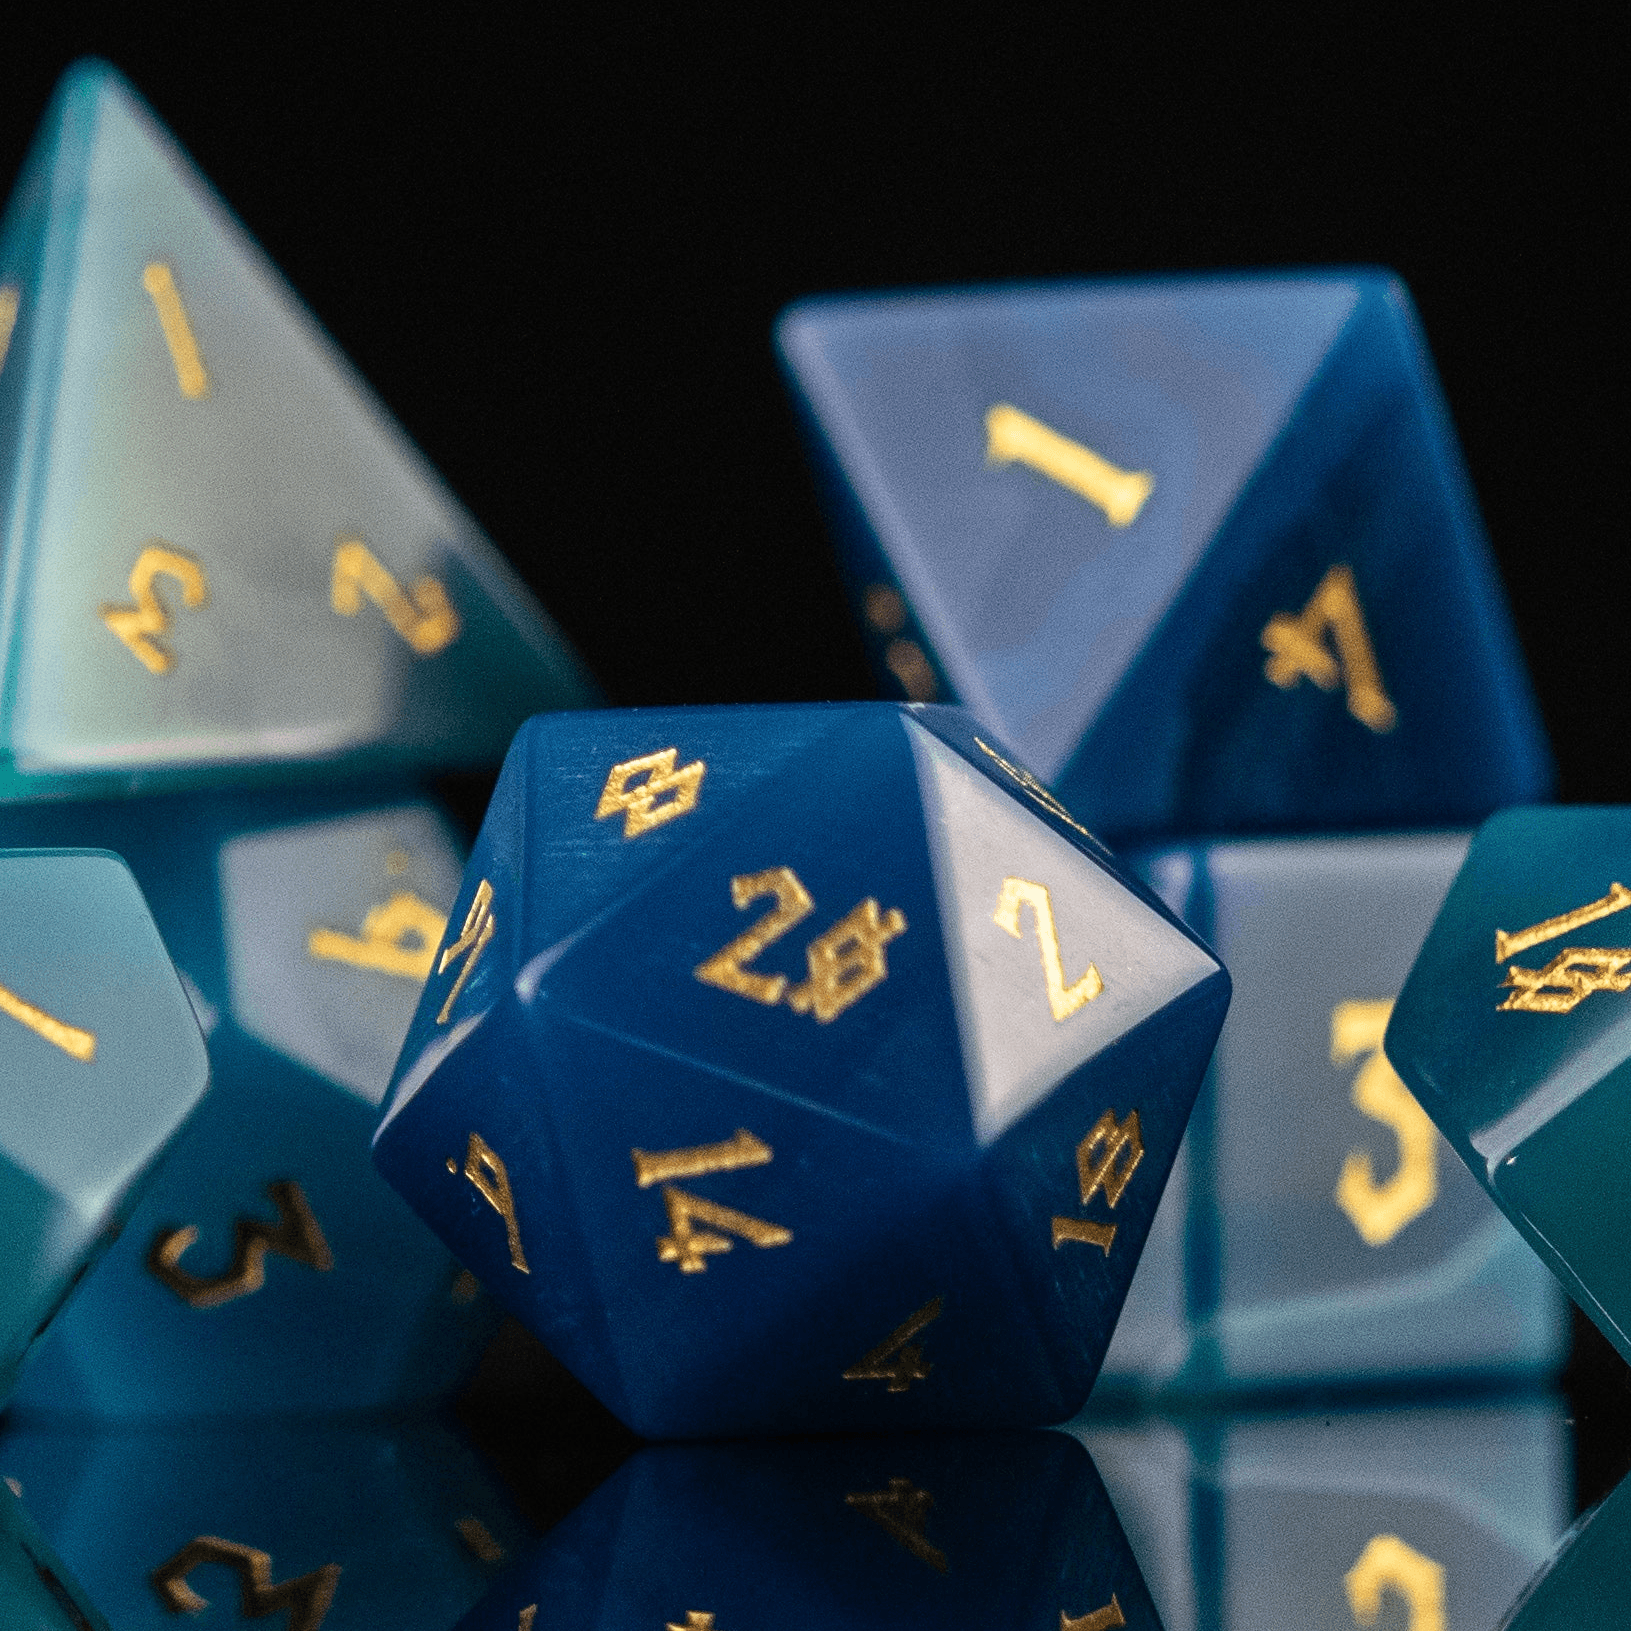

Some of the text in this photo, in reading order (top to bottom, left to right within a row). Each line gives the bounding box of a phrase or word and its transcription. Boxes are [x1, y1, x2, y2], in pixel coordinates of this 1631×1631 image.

[143, 261, 209, 398] 1
[983, 404, 1155, 527] 1
[594, 746, 707, 840] 8
[694, 866, 908, 1024] 20
[992, 875, 1105, 1022] 2
[631, 1127, 794, 1274] 14
[842, 1297, 945, 1392] 4
